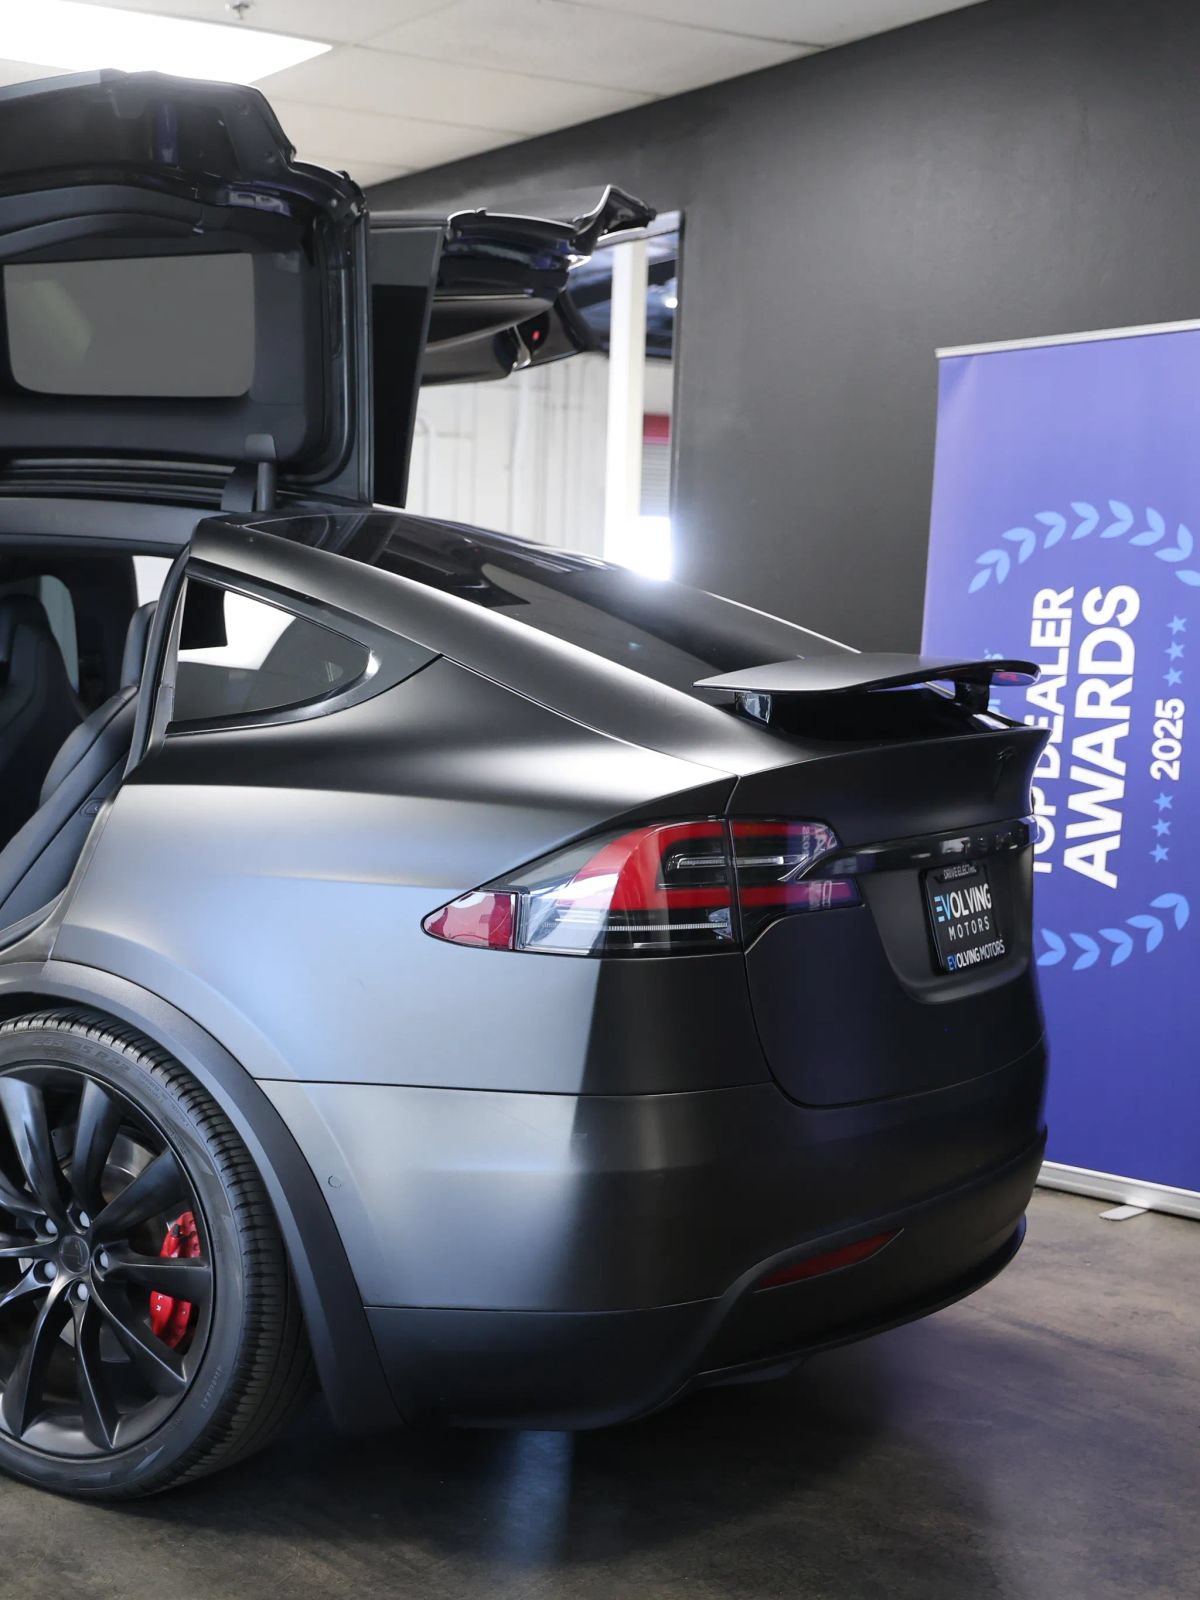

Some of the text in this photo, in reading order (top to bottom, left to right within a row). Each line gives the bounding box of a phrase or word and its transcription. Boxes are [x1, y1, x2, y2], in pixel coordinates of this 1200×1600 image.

[1024, 586, 1074, 779] DEALER
[1063, 584, 1141, 889] AWARDS
[1150, 697, 1185, 781] 2025
[934, 883, 992, 922] EVOLVING
[948, 915, 990, 941] MOTORS
